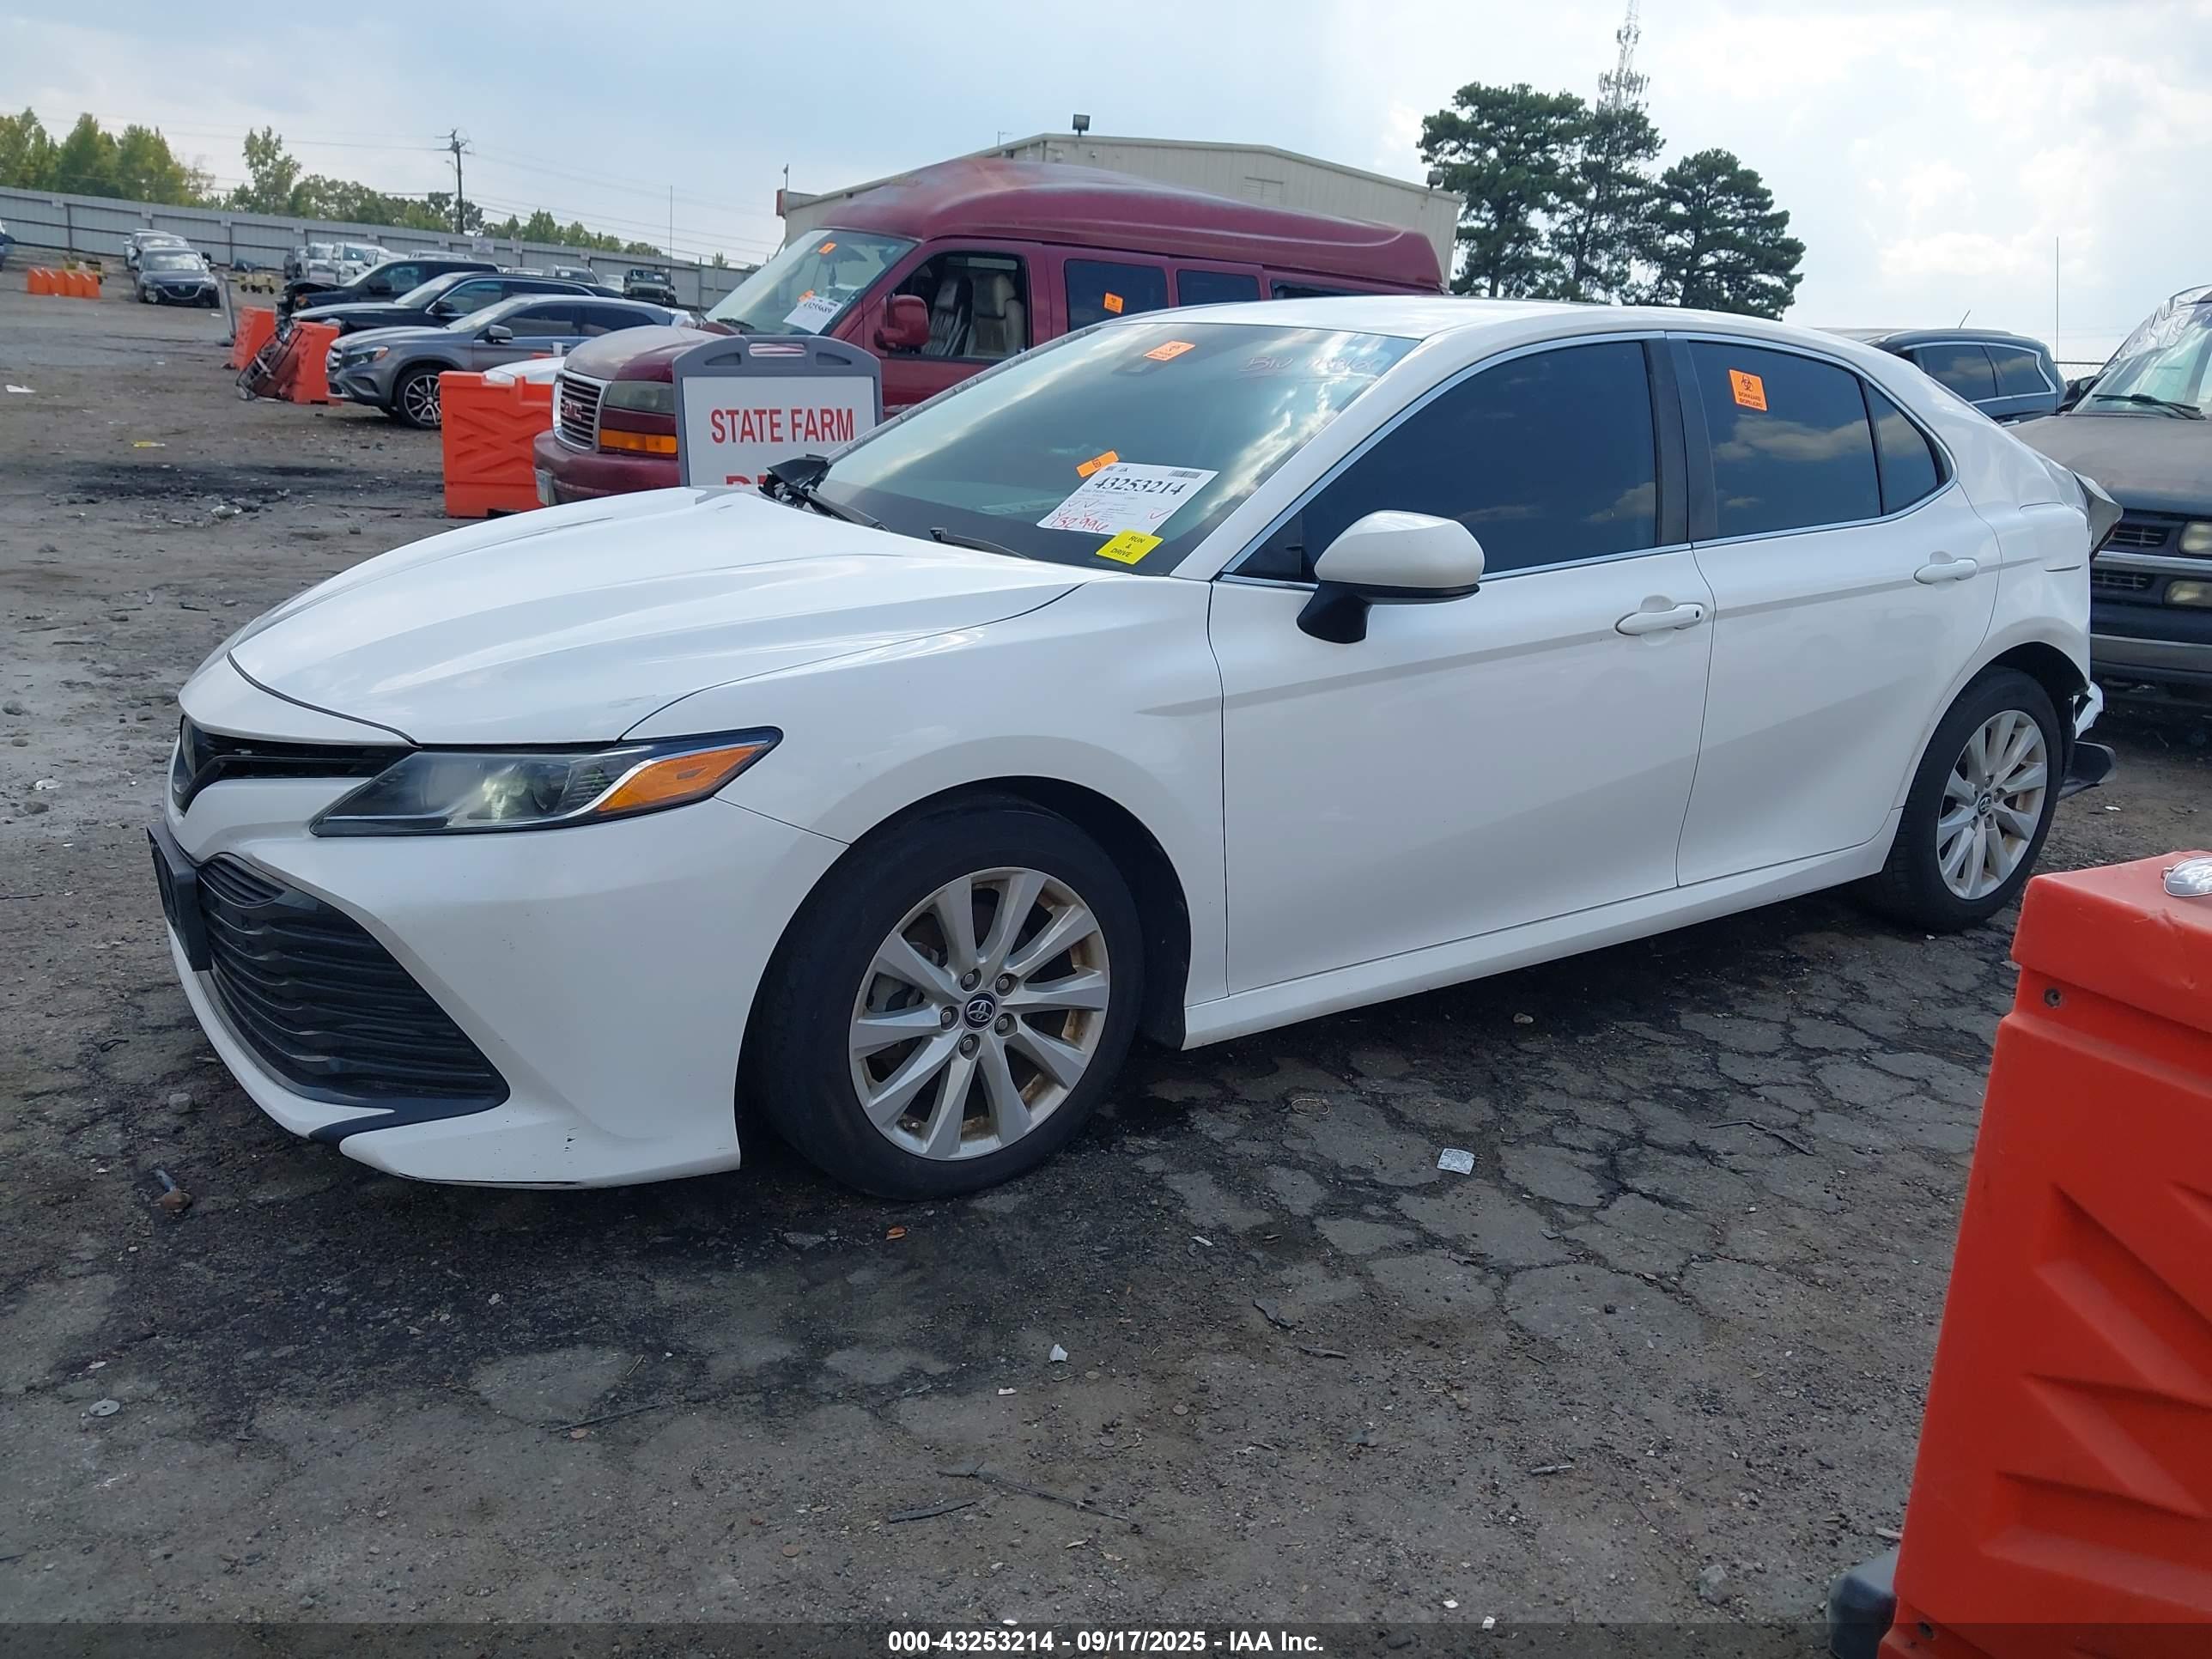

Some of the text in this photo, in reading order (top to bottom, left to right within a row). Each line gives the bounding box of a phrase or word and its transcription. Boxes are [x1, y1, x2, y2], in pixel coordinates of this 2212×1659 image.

[710, 408, 854, 444] STATE FARM
[1093, 476, 1188, 495] 43253214
[1128, 535, 1146, 544] RUN
[1109, 548, 1133, 558] DRIVE
